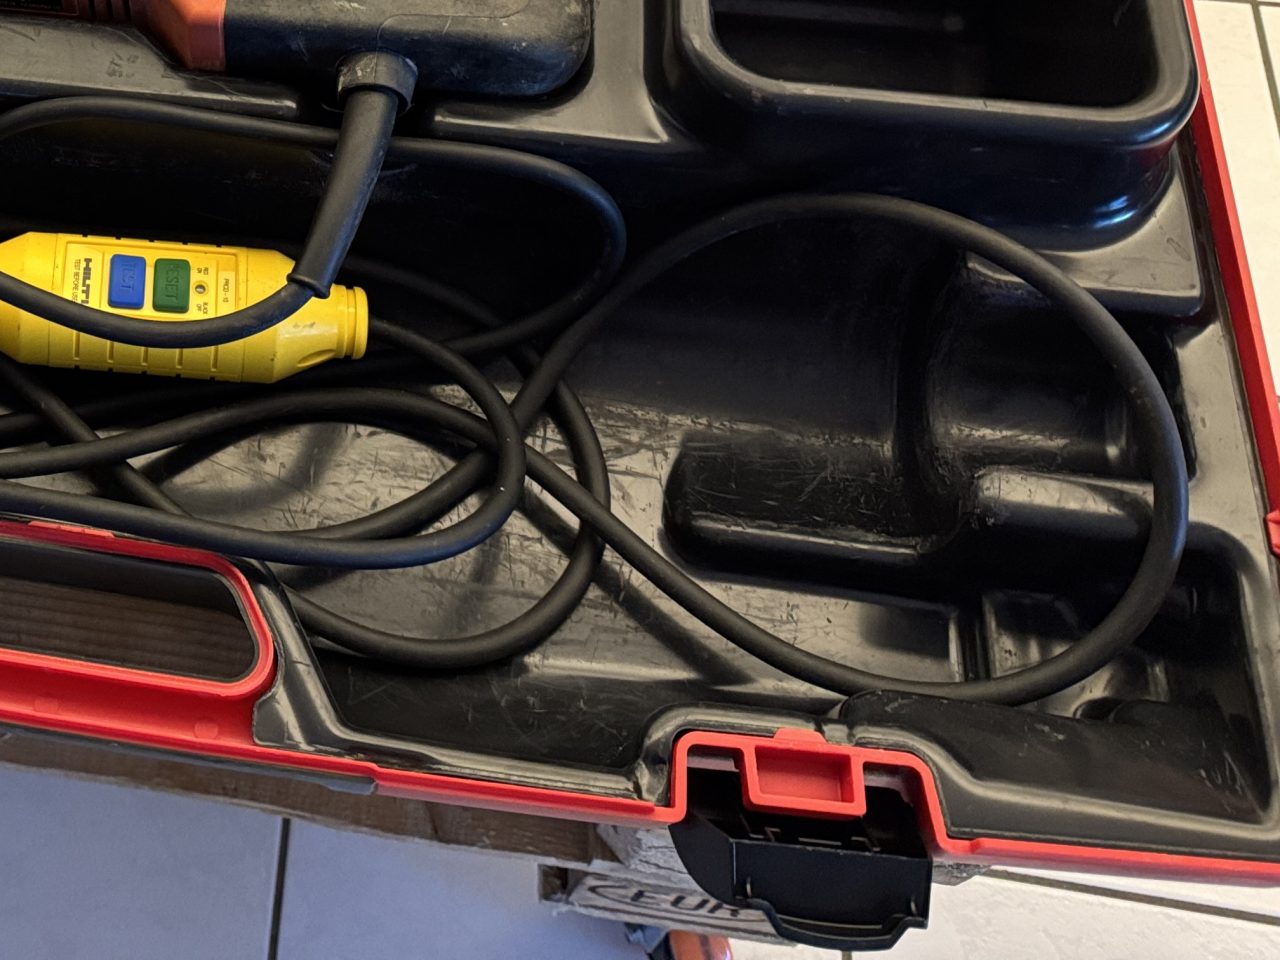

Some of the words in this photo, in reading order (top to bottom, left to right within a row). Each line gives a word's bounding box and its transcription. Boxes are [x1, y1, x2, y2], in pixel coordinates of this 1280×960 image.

[81, 258, 93, 305] HILTI
[120, 262, 137, 291] TEST
[165, 263, 180, 301] RESET
